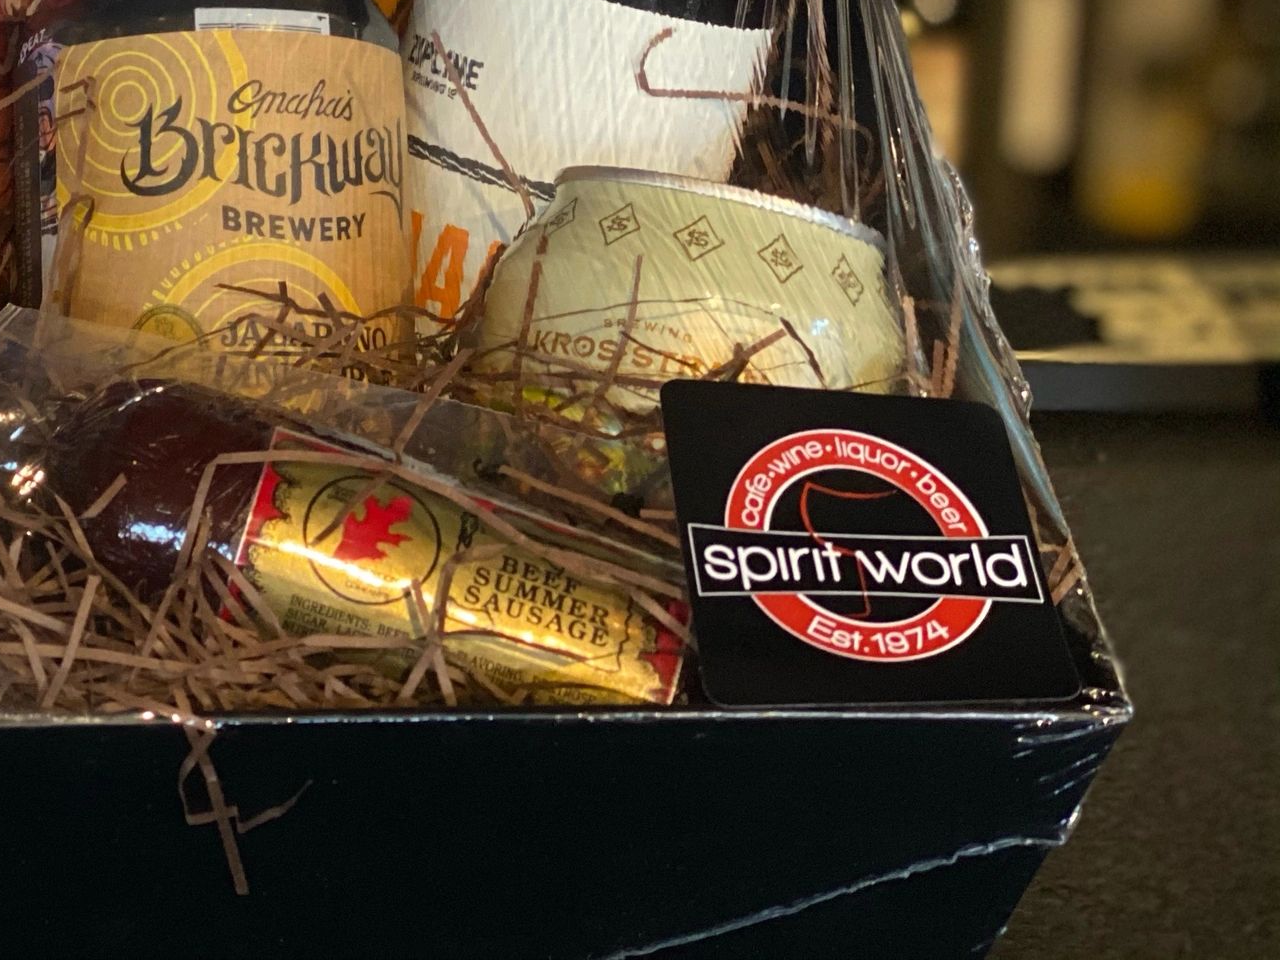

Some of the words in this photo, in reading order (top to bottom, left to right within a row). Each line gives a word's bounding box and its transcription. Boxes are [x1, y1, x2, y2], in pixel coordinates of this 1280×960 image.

[227, 78, 355, 122] Omaha's
[221, 204, 368, 242] BREWERY
[221, 318, 388, 354] JAAPNO
[603, 317, 694, 344] BREWING
[740, 473, 773, 528] cafe
[769, 439, 824, 477] wine
[833, 435, 912, 476] liquor
[914, 472, 969, 536] beer
[500, 554, 585, 597] BEEF
[703, 540, 844, 591] spirit
[854, 541, 1029, 589] world
[463, 584, 611, 648] SAUSAGE
[472, 566, 610, 627] SUMMER
